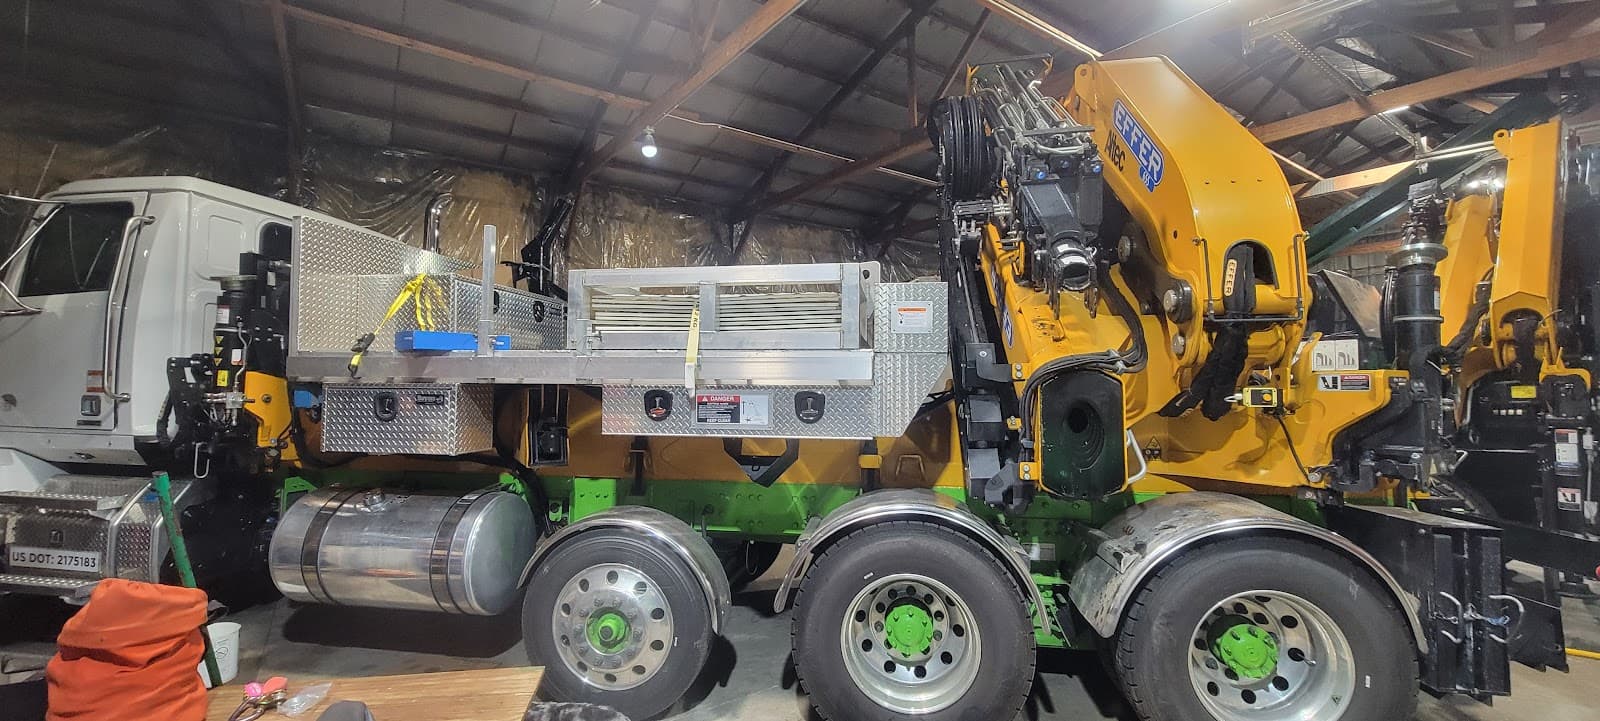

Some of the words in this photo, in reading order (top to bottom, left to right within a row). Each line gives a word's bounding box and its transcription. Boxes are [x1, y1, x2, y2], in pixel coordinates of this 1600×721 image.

[1104, 128, 1126, 172] Altec
[1114, 102, 1162, 183] EFFER
[1226, 262, 1236, 294] EFFER
[12, 551, 26, 562] US
[29, 553, 55, 564] DOT:
[57, 555, 96, 568] 2175183
